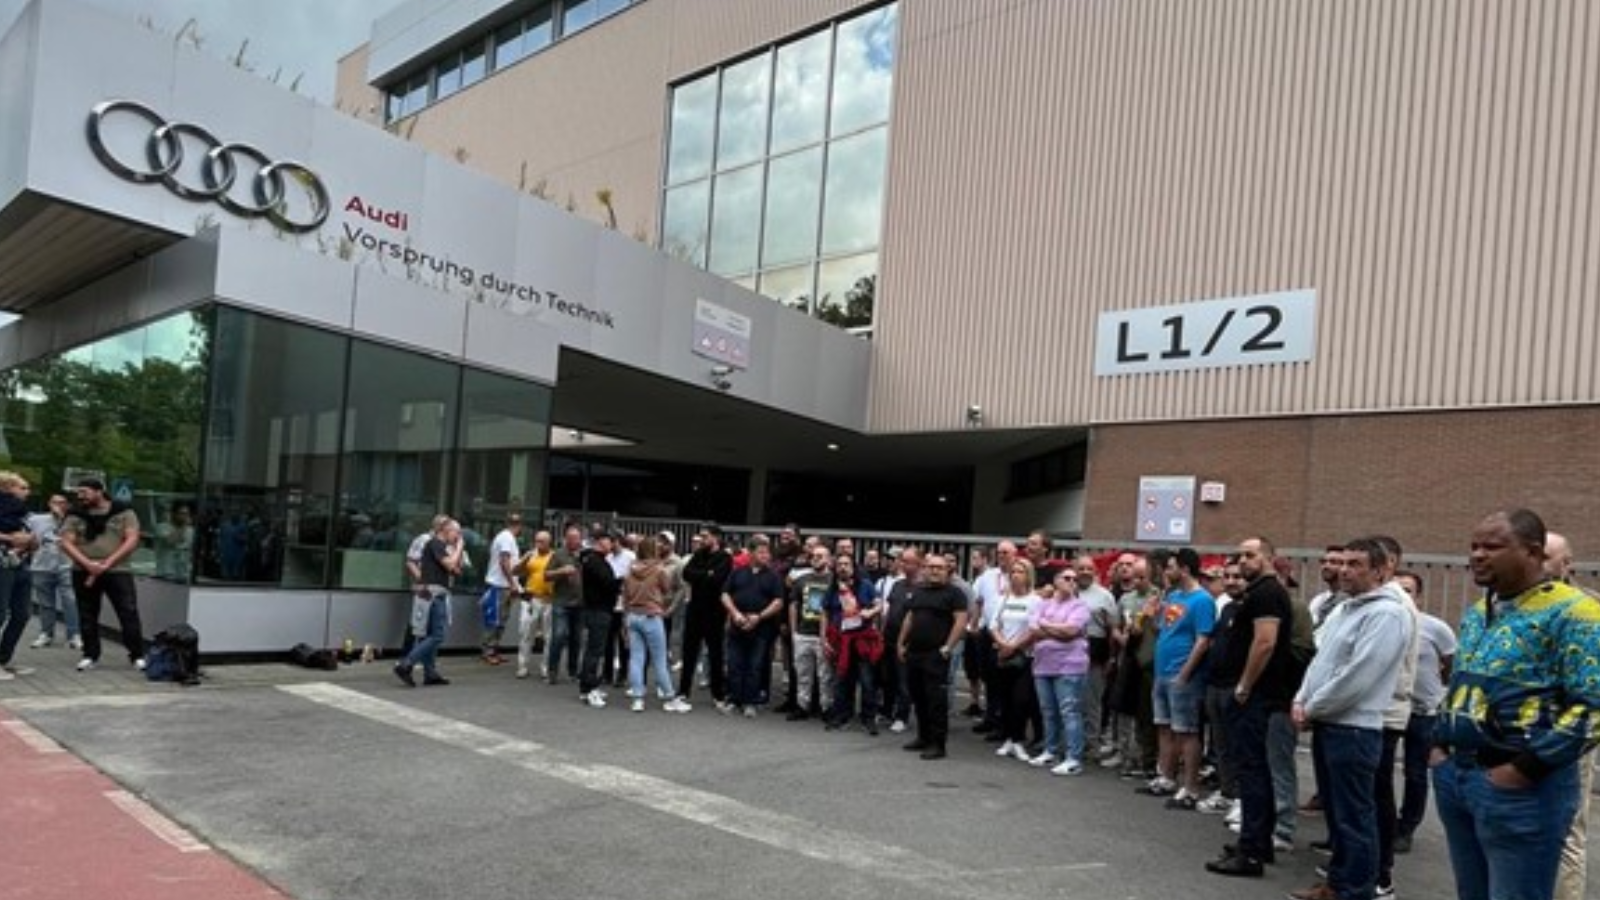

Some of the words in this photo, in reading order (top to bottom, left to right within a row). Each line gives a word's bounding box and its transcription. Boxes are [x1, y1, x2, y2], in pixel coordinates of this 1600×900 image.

[345, 196, 408, 231] Audi
[342, 221, 474, 286] Vorsprung
[480, 272, 541, 304] durch
[546, 291, 614, 329] Technik
[1115, 305, 1286, 364] L1/2
